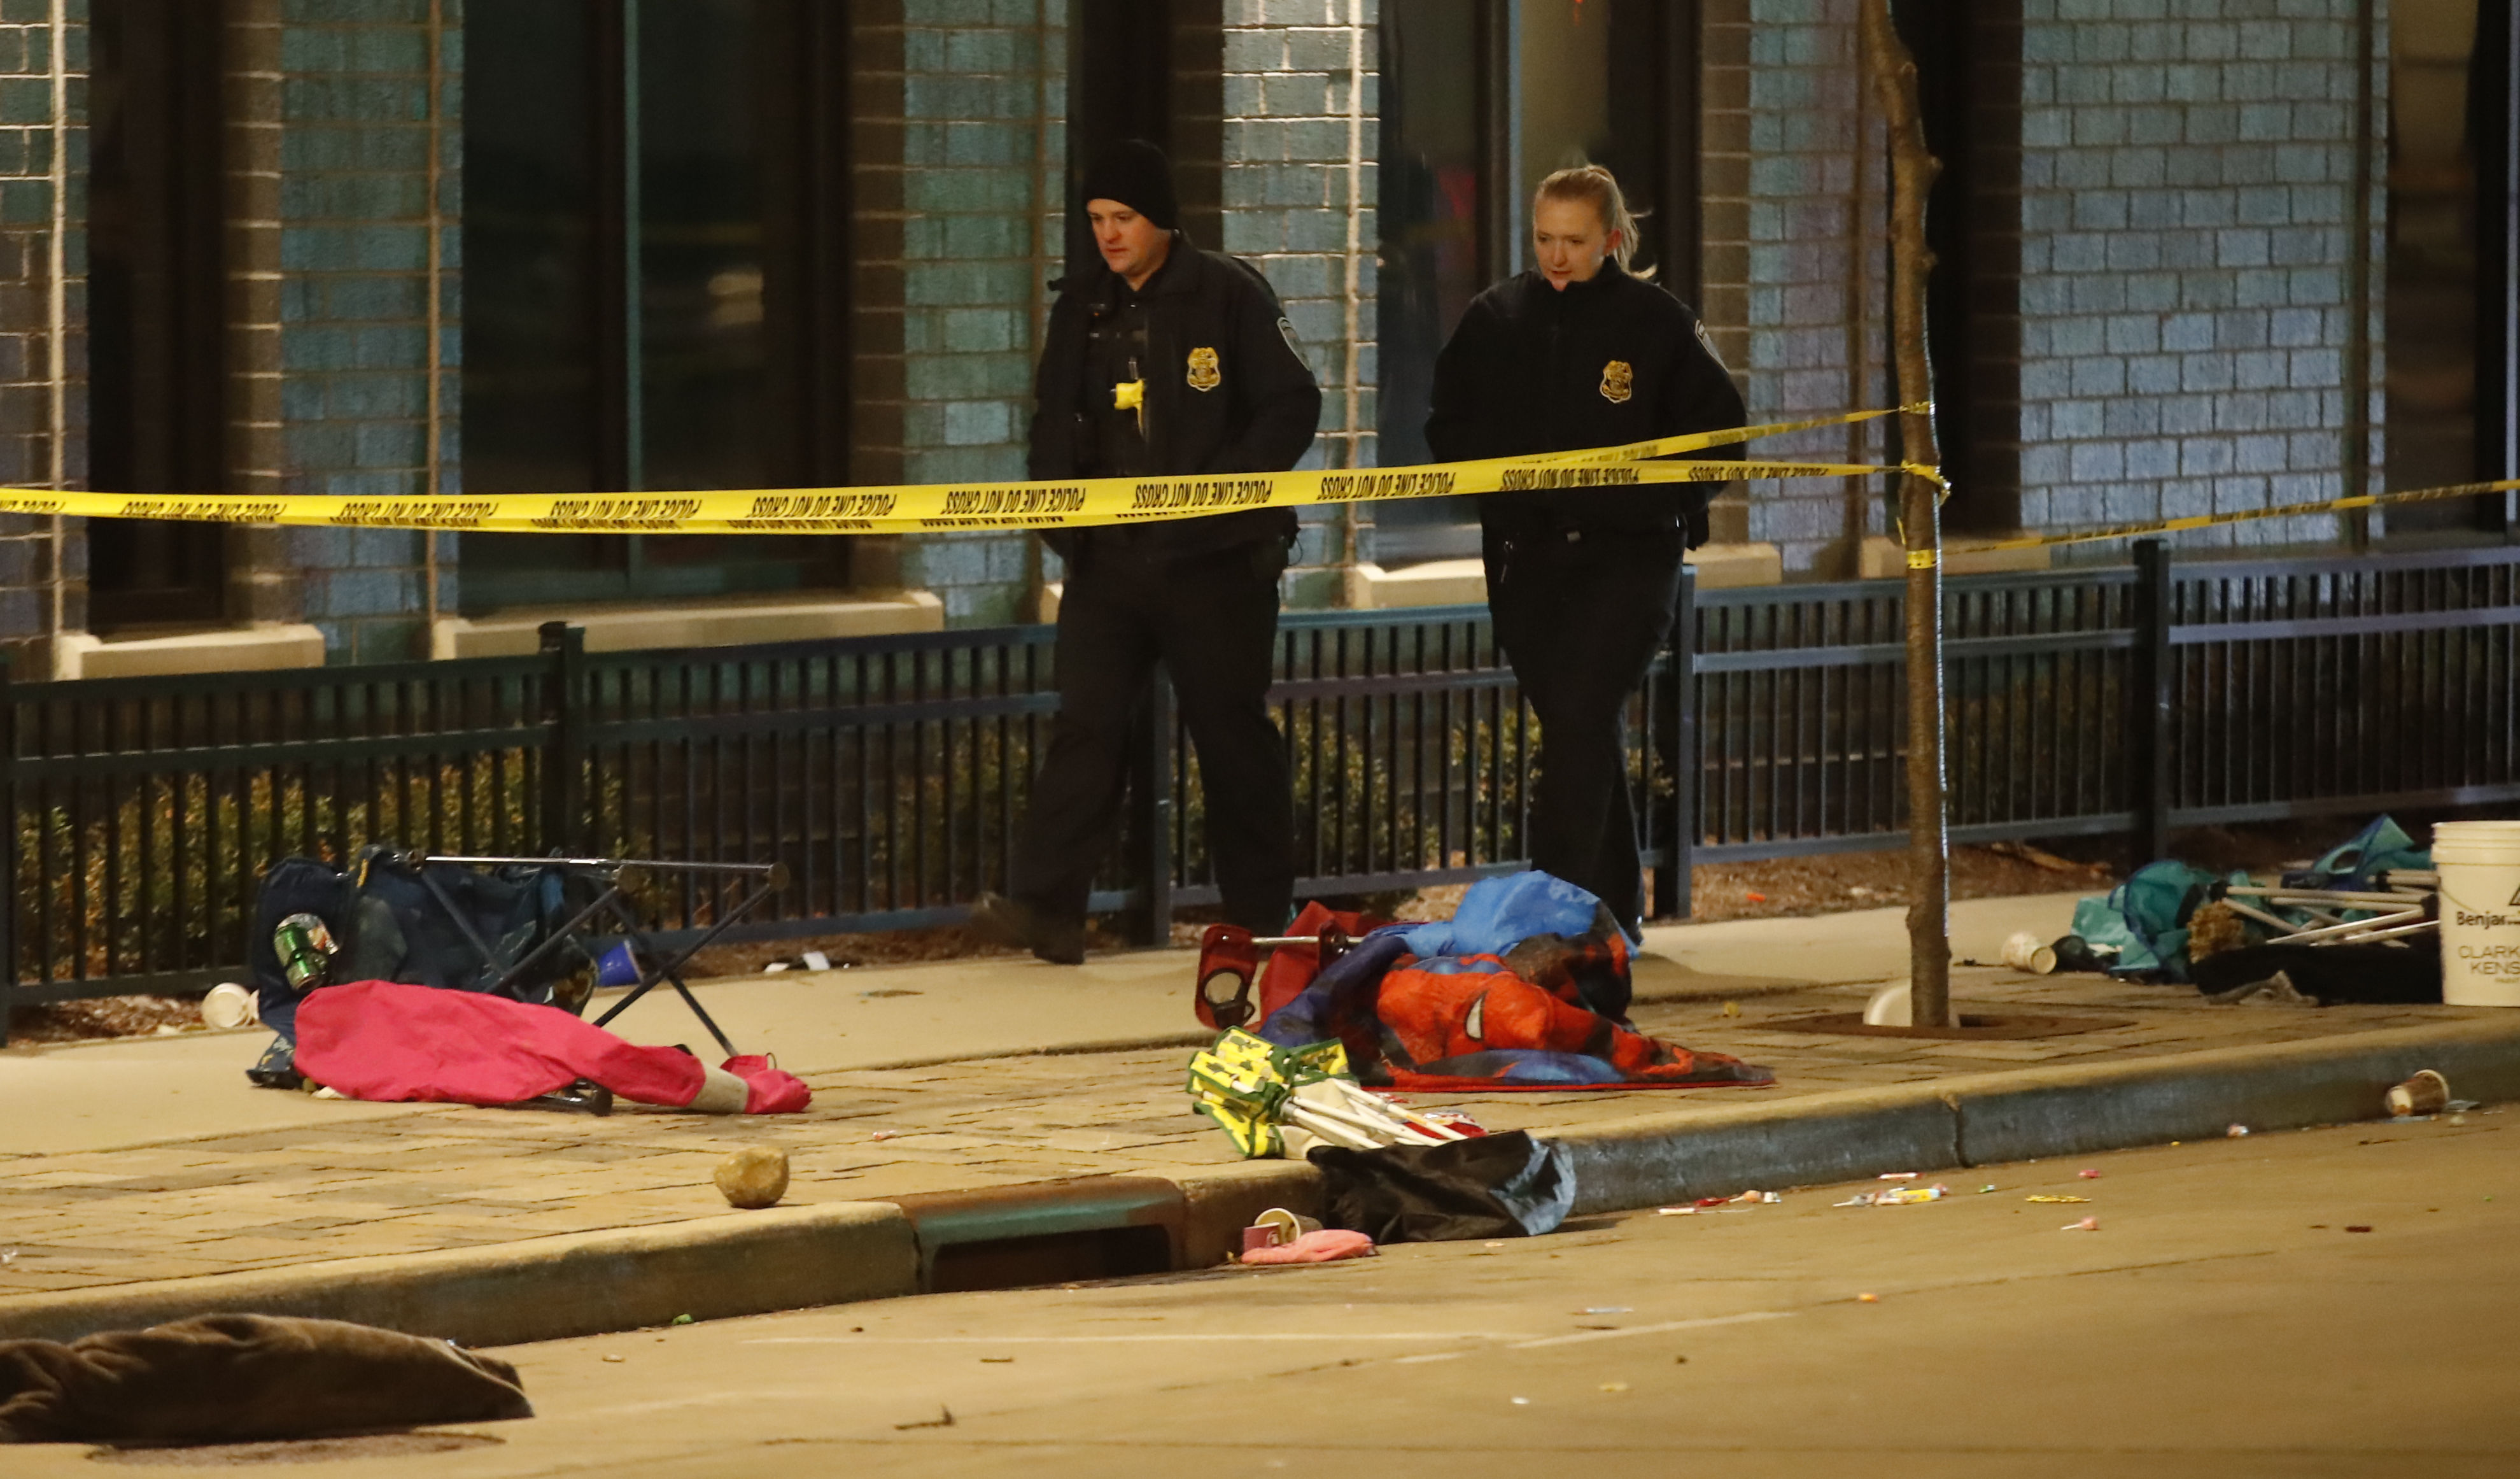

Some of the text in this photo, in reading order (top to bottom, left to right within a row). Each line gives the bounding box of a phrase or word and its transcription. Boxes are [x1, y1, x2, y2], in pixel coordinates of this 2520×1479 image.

[1131, 480, 1272, 509] POLICE LINE DO NOT CROSS
[1316, 472, 1456, 500] POLICE LINE DO NOT CROSS
[745, 493, 897, 518] POLICE LINE DO NOT CROSS
[940, 488, 1086, 515] POLICE LINE DO NOT CROSS
